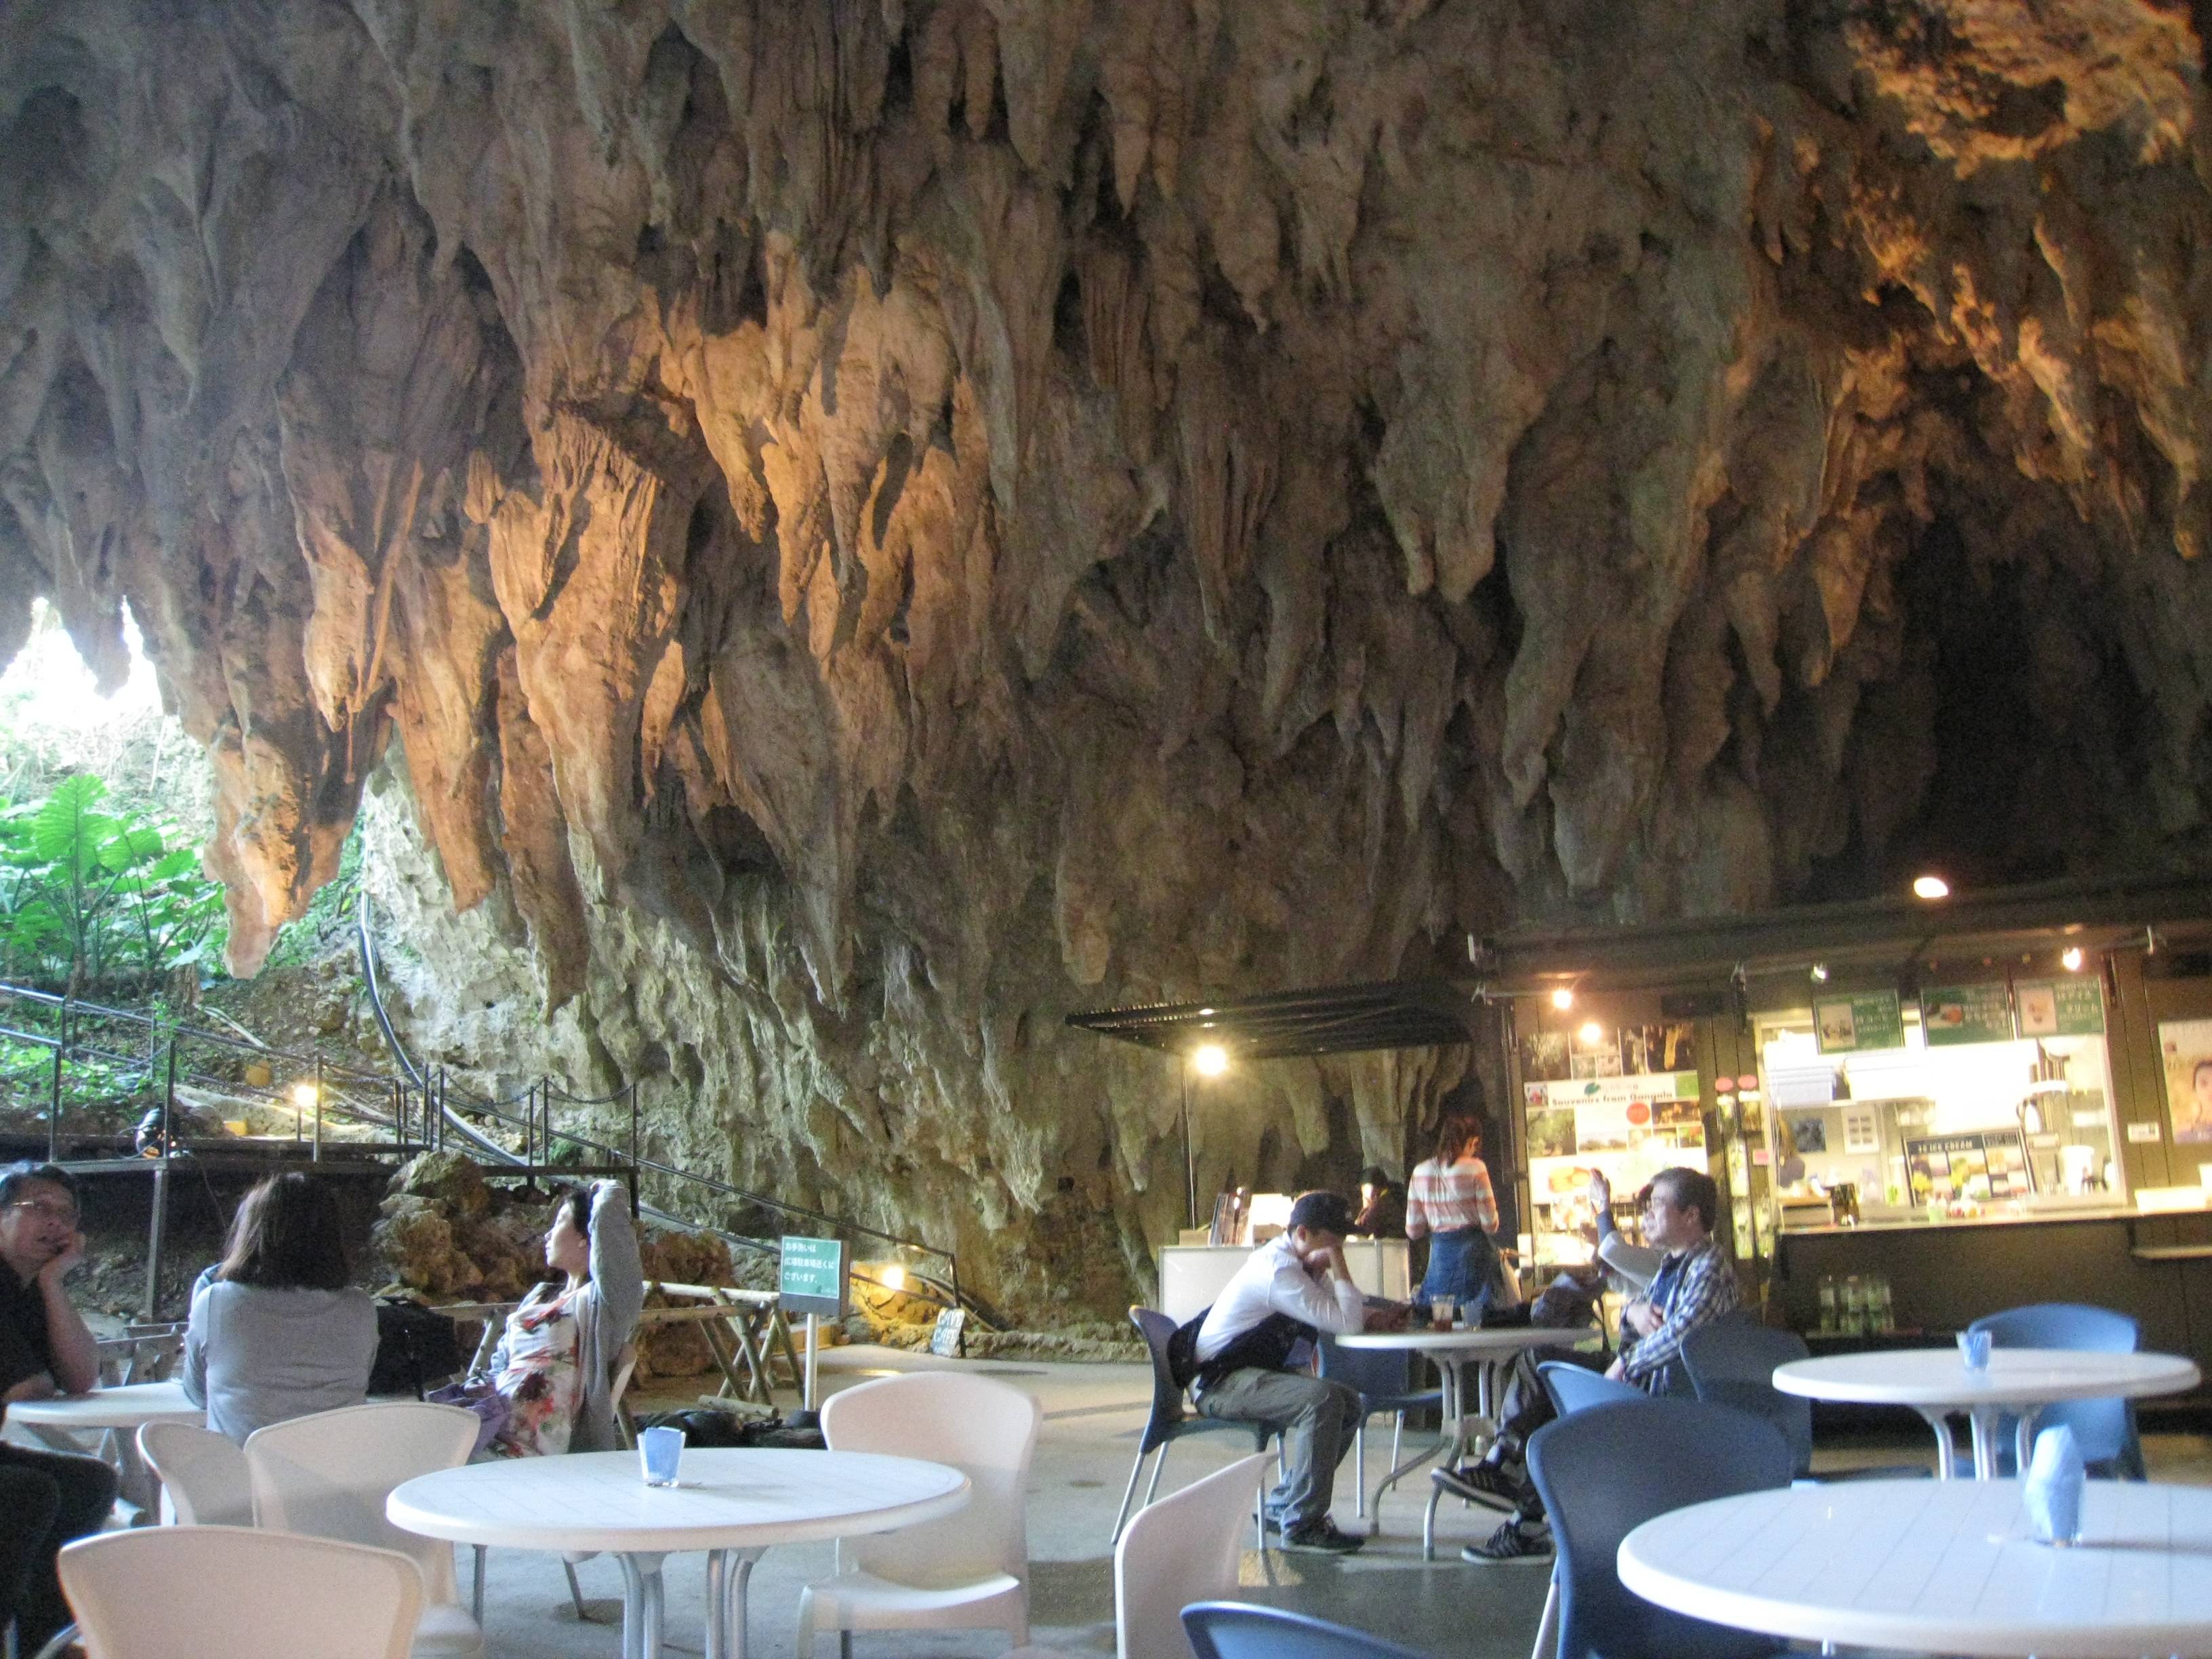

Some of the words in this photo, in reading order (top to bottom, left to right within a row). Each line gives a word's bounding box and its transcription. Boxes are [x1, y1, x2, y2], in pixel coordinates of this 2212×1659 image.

[1603, 1094, 1626, 1103] from
[1944, 1140, 1973, 1151] CREAM
[937, 1309, 964, 1327] CAVE
[933, 1327, 960, 1345] CAFE
